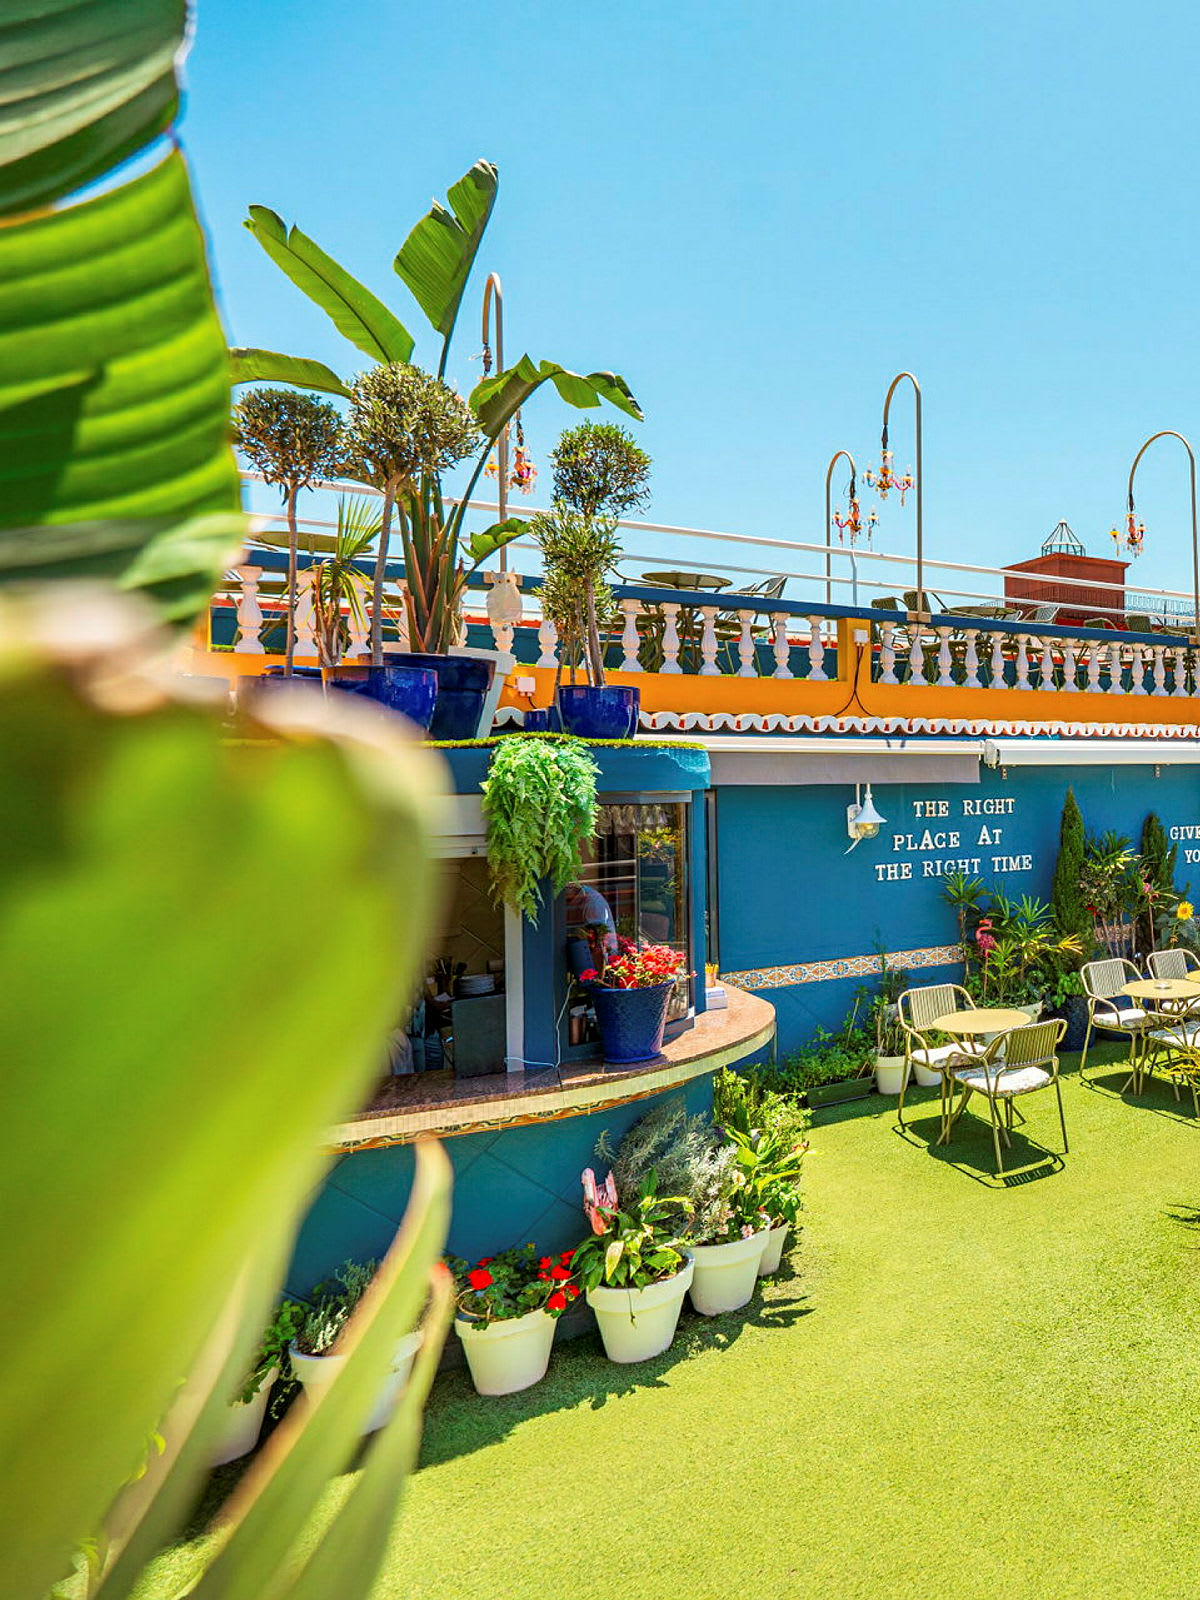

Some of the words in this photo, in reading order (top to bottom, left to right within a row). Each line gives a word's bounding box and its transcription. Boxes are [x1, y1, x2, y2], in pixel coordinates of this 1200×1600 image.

[913, 801, 949, 817] THE
[963, 798, 1015, 815] RIGHT
[892, 829, 960, 851] PLACE
[977, 825, 1002, 845] AT
[875, 863, 912, 881] THE
[922, 858, 981, 877] RIGHT
[991, 854, 1032, 872] TIME
